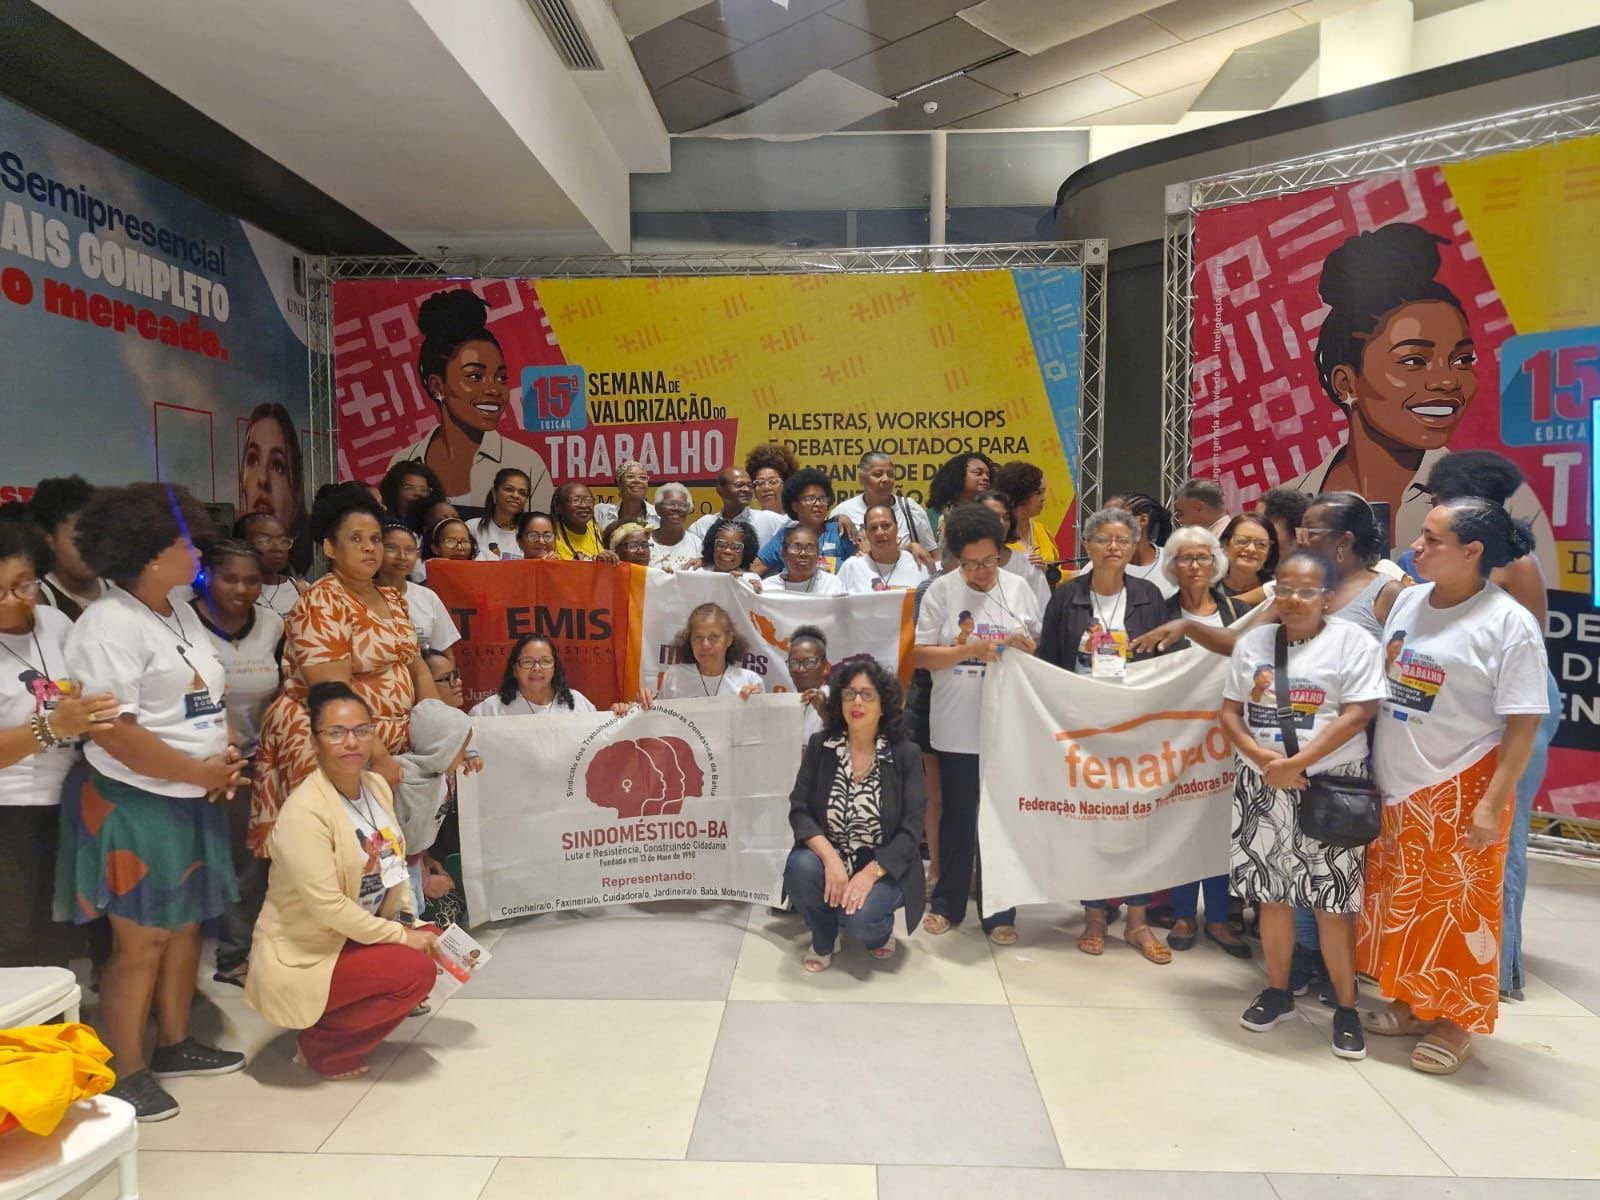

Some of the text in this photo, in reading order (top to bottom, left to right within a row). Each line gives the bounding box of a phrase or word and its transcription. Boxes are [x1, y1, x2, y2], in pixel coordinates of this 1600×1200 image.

[0, 152, 226, 277] Semipresencial
[78, 231, 229, 323] COMPLETO
[44, 277, 229, 361] mercado.
[588, 370, 681, 396] SEMANA DE
[590, 393, 726, 424] VALORIZAÇÃO DO
[768, 410, 1006, 433] PALESTRAS, WORKSHOPS
[545, 429, 723, 479] TRABALHO
[783, 436, 1030, 456] DEBATES VOLTADOS PARA
[1542, 452, 1590, 527] T
[1567, 550, 1592, 575] D
[451, 605, 613, 641] TEMIS
[1402, 664, 1443, 684] RABALHO
[575, 747, 586, 761] dos
[566, 763, 578, 797] Sindicato
[710, 763, 718, 773] da
[710, 774, 719, 797] Bahia
[1018, 796, 1076, 816] Federação
[1079, 799, 1130, 816] Nacional
[1132, 799, 1152, 814] das
[561, 818, 729, 850] SINDOMÉSTICO-BA
[565, 852, 584, 862] Luta
[593, 846, 642, 858] Resistência,
[643, 841, 691, 853] Construindo
[693, 839, 727, 851] Cidadania
[600, 857, 627, 868] Fundada
[648, 853, 656, 862] de
[656, 852, 672, 862] Maio
[673, 851, 681, 860] de
[601, 870, 696, 888] Representando:
[501, 902, 554, 916] Cozinheira/o,
[555, 896, 601, 909] Faxineira/o,
[602, 890, 652, 903] Cuidadora/o,
[653, 887, 699, 898] Jardineira/o,
[700, 886, 720, 897] Babá,
[753, 891, 770, 901] outros
